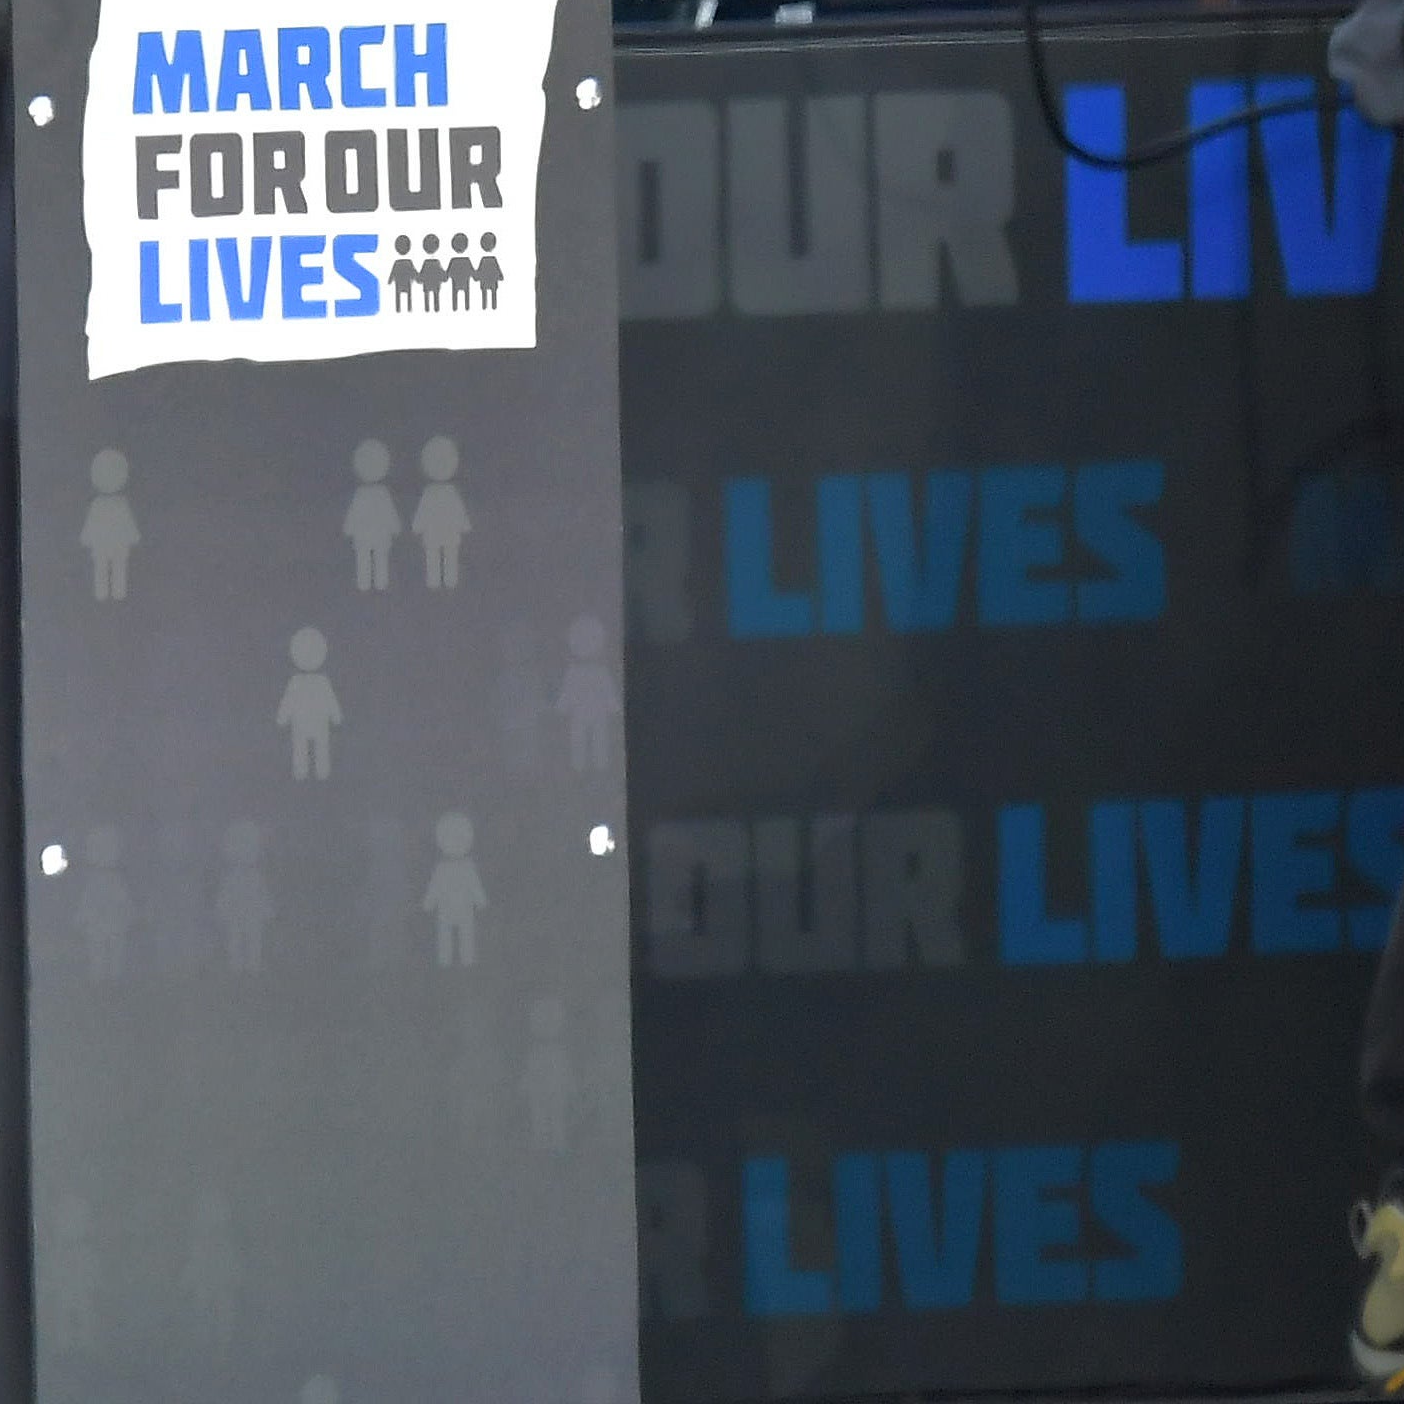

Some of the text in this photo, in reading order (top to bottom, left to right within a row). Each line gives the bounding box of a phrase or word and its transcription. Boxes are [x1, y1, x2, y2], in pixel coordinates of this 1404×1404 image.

[132, 23, 449, 115] MARCH
[136, 125, 504, 220] FOR OUR
[139, 233, 382, 324] LIVES
[723, 459, 1167, 641] LIVES
[644, 809, 964, 976] OUR
[741, 1139, 1186, 1319] LIVES
